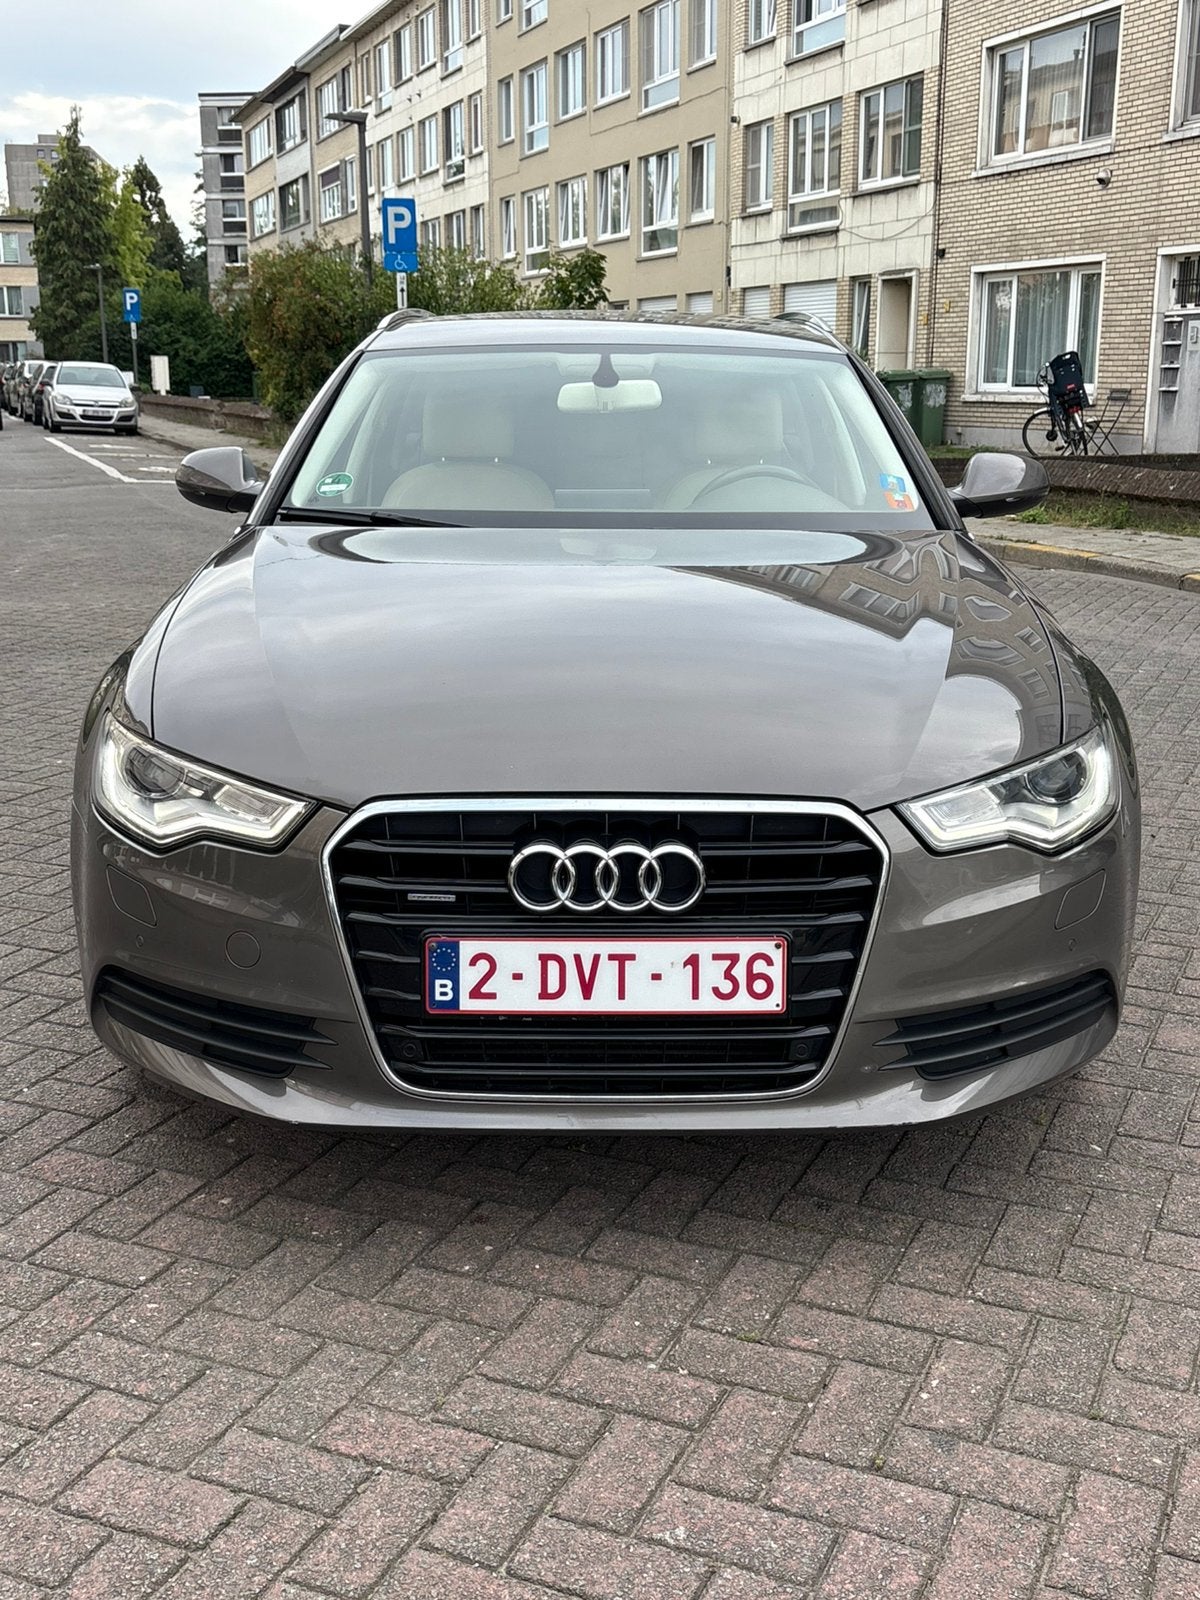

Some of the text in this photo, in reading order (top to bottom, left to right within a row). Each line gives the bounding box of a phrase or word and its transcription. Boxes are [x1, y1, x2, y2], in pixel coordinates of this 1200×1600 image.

[387, 206, 411, 244] P
[125, 292, 138, 311] P
[434, 979, 454, 1001] B
